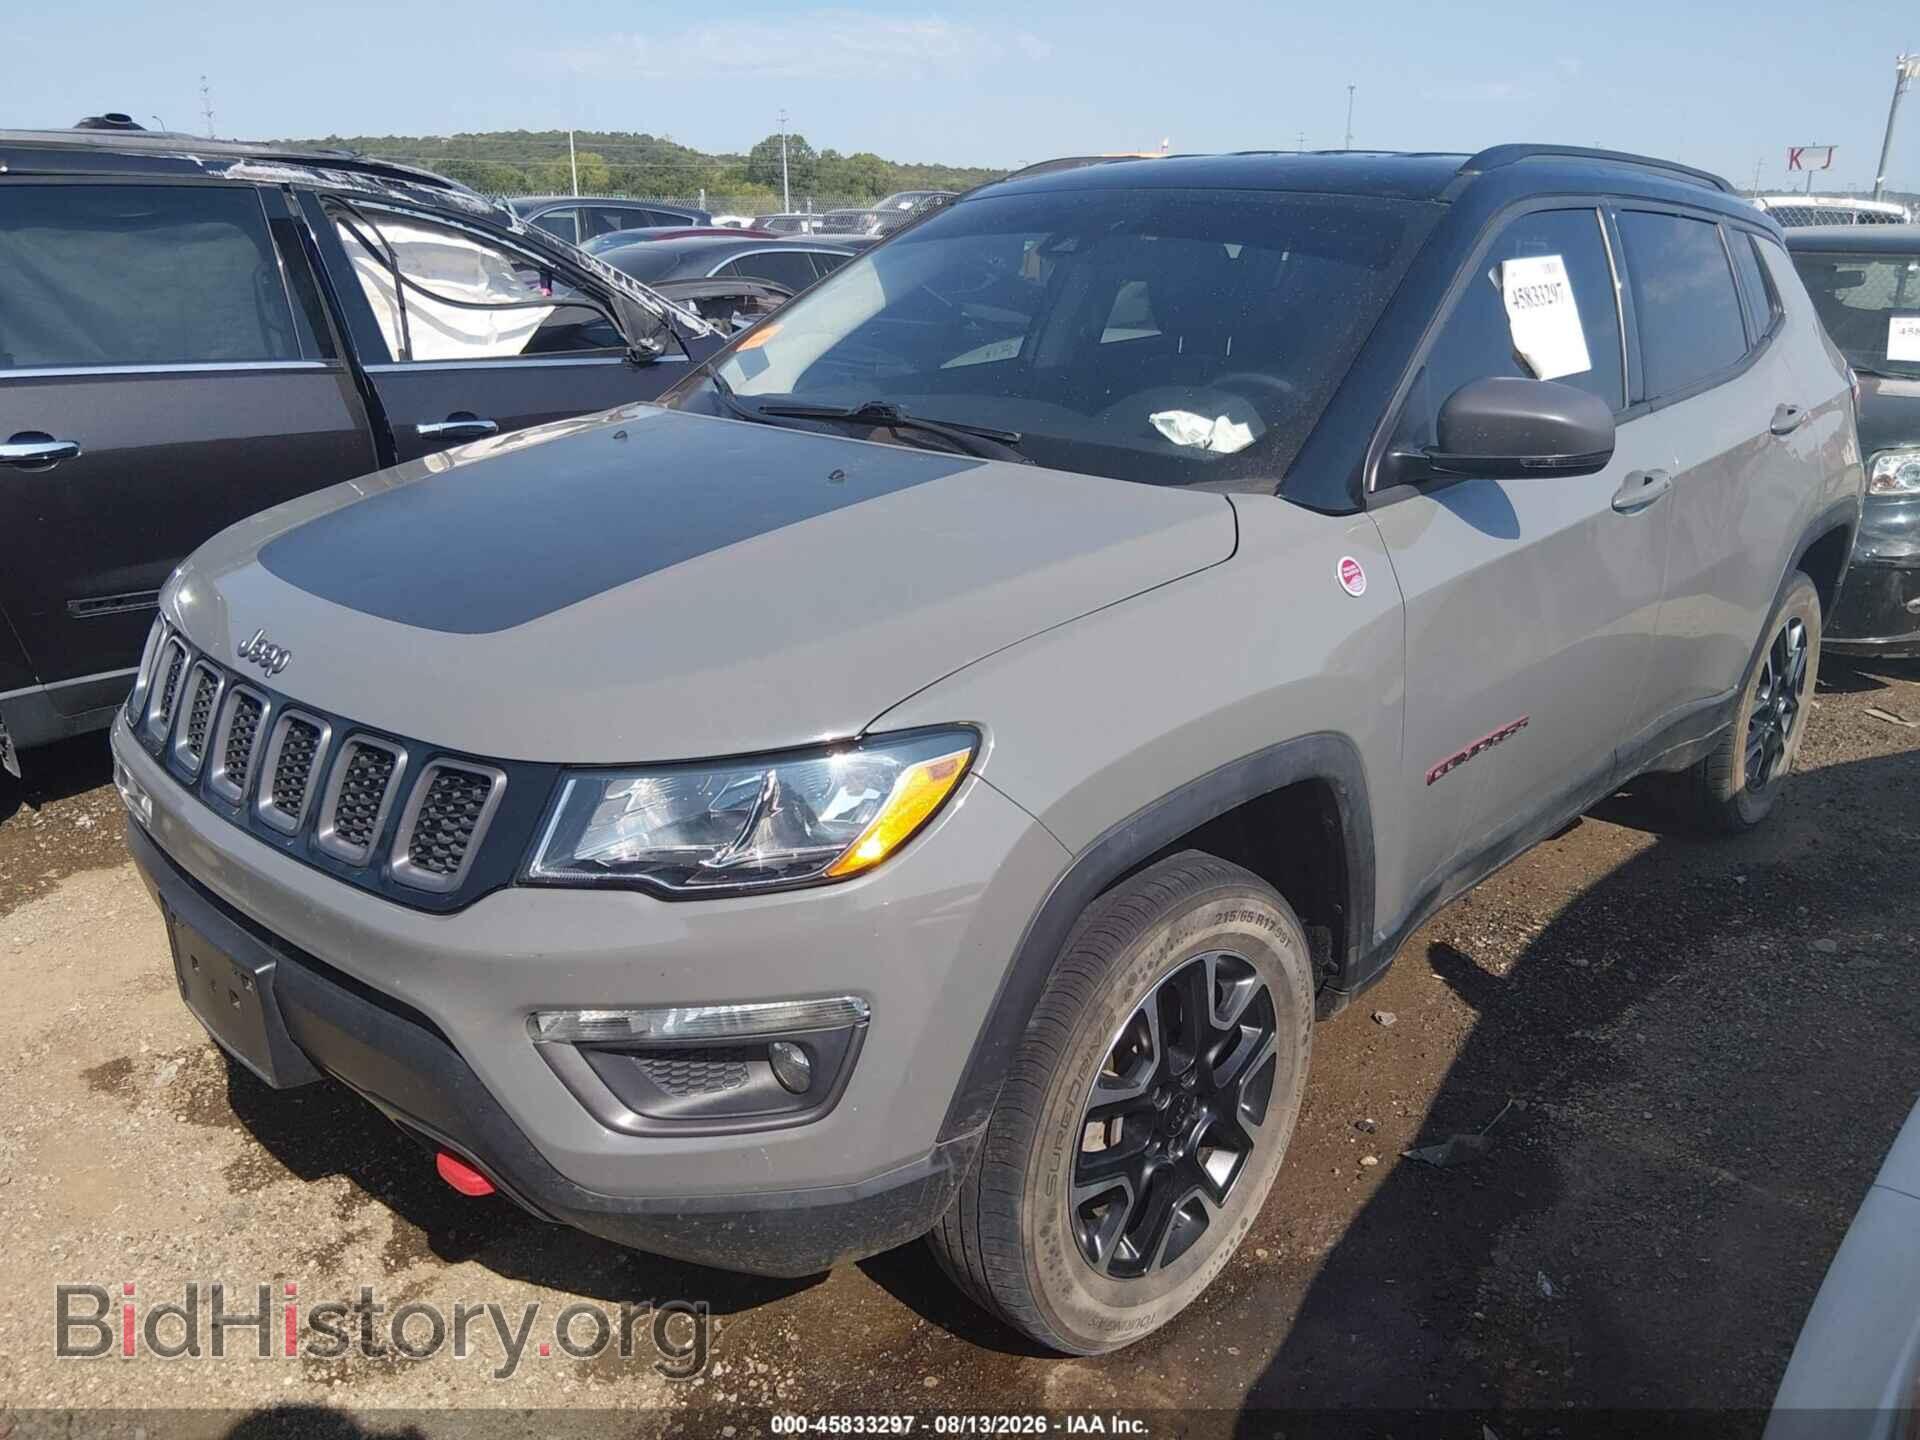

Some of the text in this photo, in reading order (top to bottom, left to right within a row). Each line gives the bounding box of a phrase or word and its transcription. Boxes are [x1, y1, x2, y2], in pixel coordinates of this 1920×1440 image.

[1789, 147, 1832, 170] K J
[1512, 281, 1563, 309] 45833297
[237, 628, 291, 678] Jeep
[1214, 909, 1255, 926] 215/65
[1255, 911, 1277, 931] R17
